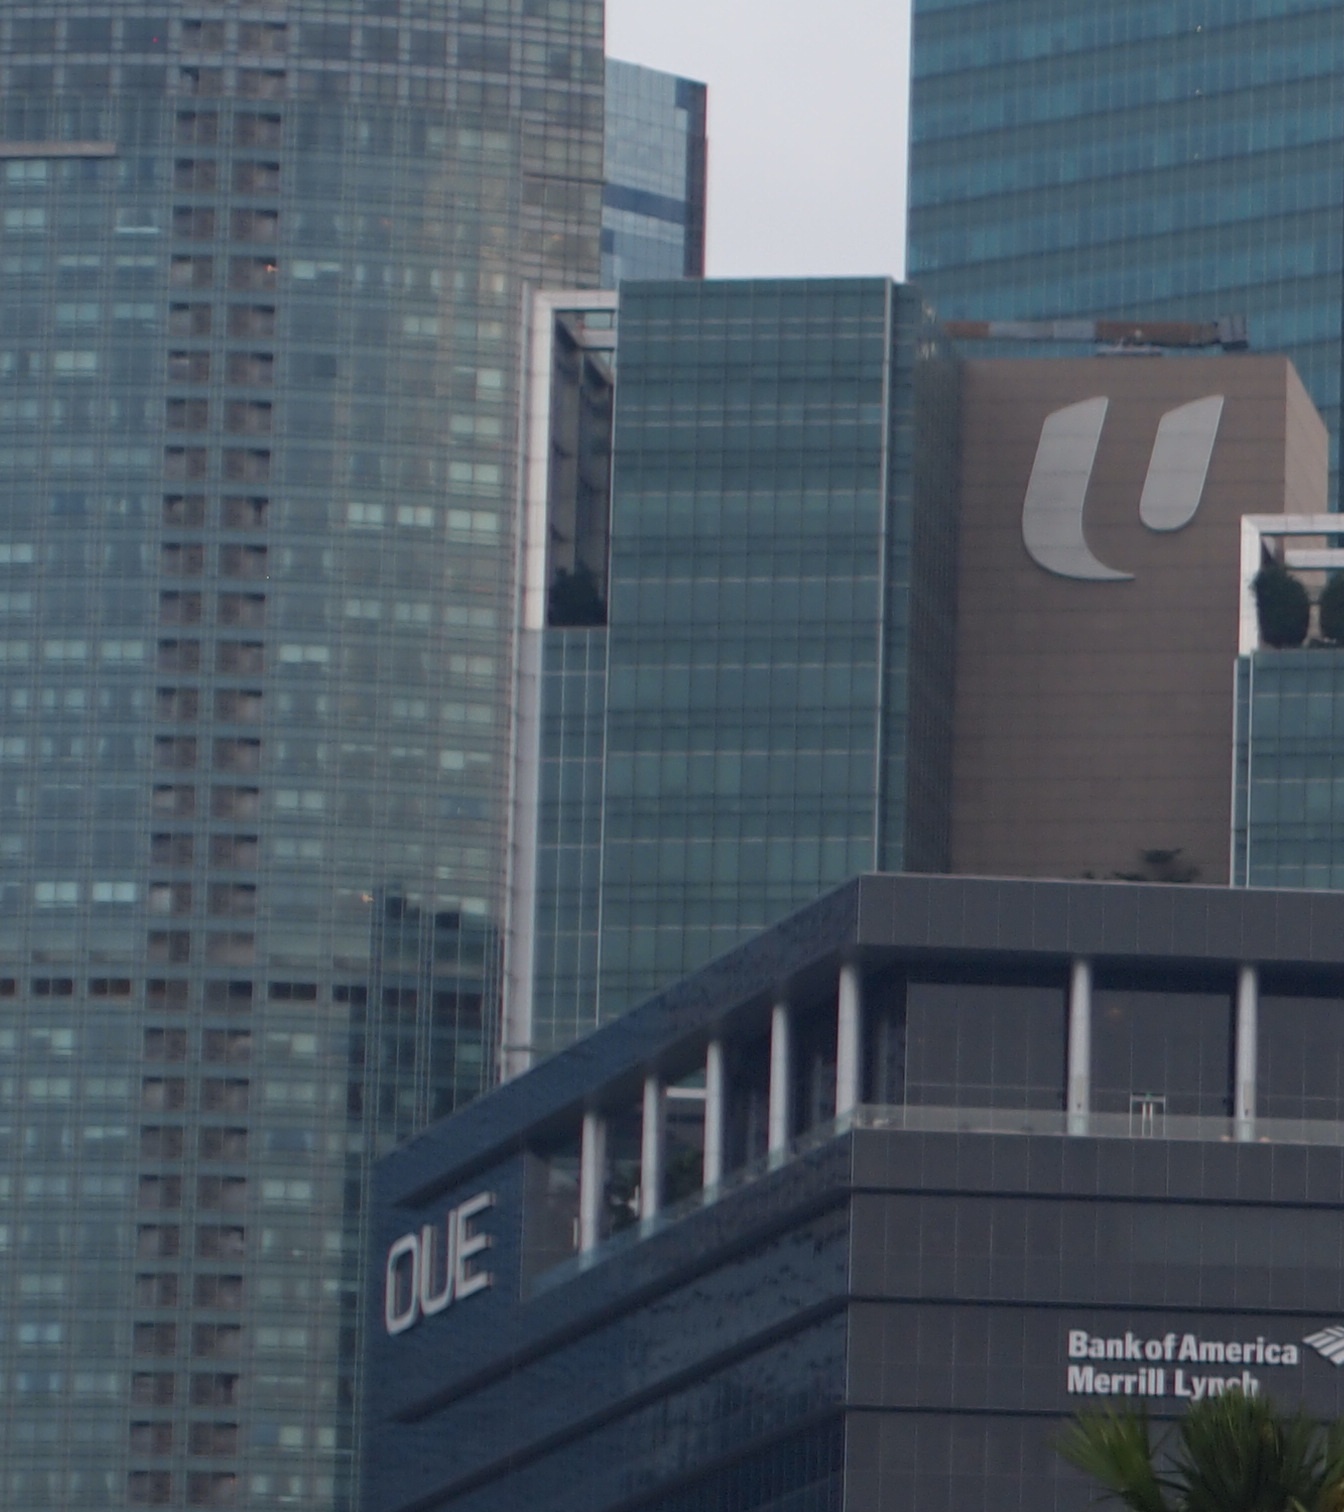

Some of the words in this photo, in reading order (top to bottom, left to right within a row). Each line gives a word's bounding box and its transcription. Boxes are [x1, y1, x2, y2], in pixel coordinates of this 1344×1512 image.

[384, 1191, 496, 1337] OUE
[1068, 1329, 1145, 1360] Bank
[1144, 1333, 1177, 1361] of
[1178, 1334, 1299, 1365] America
[1067, 1365, 1164, 1396] Merrill
